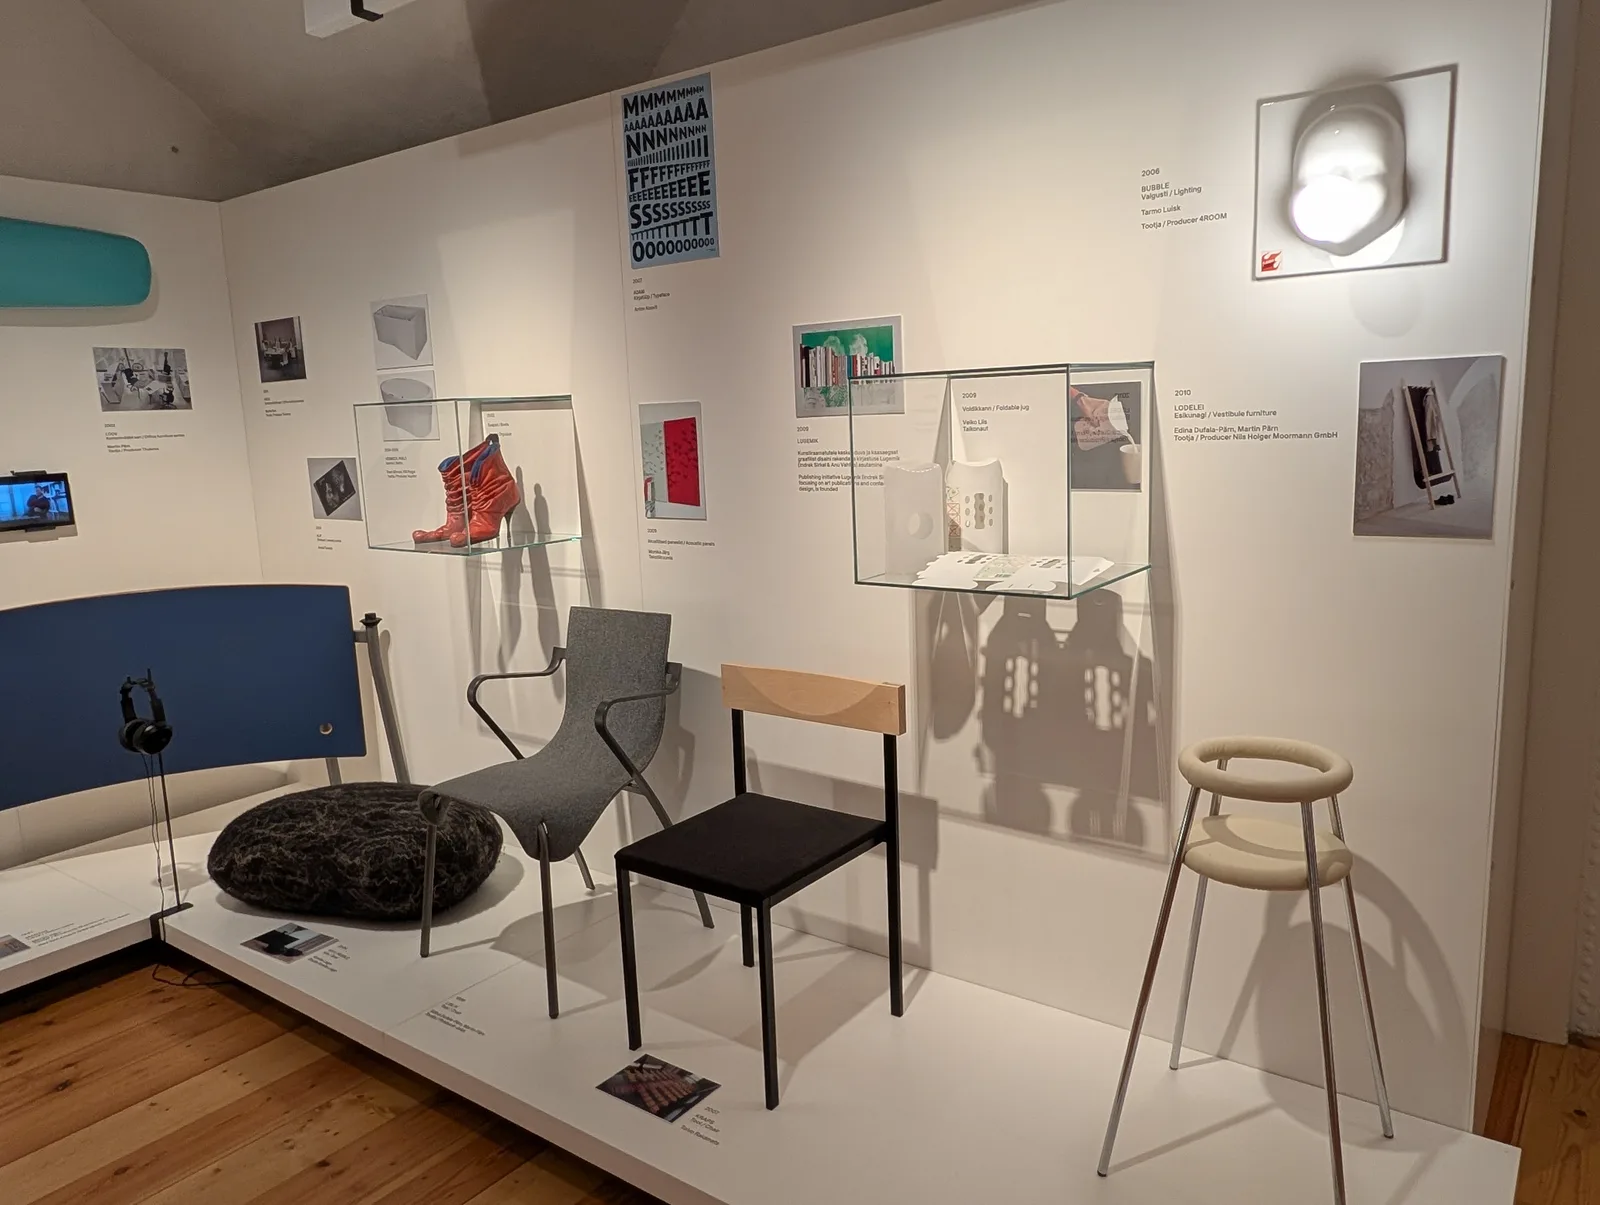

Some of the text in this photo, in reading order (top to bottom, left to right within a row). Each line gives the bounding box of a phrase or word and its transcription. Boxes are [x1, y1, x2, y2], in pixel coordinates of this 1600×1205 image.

[1141, 168, 1160, 177] 2006
[1141, 182, 1170, 192] BUBBLE
[1141, 191, 1168, 201] Valgusti
[1173, 186, 1202, 197] Lighting
[1141, 205, 1182, 216] Tarmo Luisk
[1141, 221, 1161, 230] Tootja
[1166, 217, 1198, 227] Producer
[1199, 212, 1228, 222] 4ROOM
[1174, 389, 1192, 397] 2010
[1174, 412, 1207, 420] Esikunagi
[1245, 409, 1277, 417] furniture
[1237, 425, 1261, 433] Martin
[1262, 424, 1279, 432] Pärn
[1174, 434, 1194, 442] Tootja
[1248, 433, 1272, 441] Holger
[1272, 432, 1313, 440] Moormann
[1314, 431, 1338, 439] GmbH
